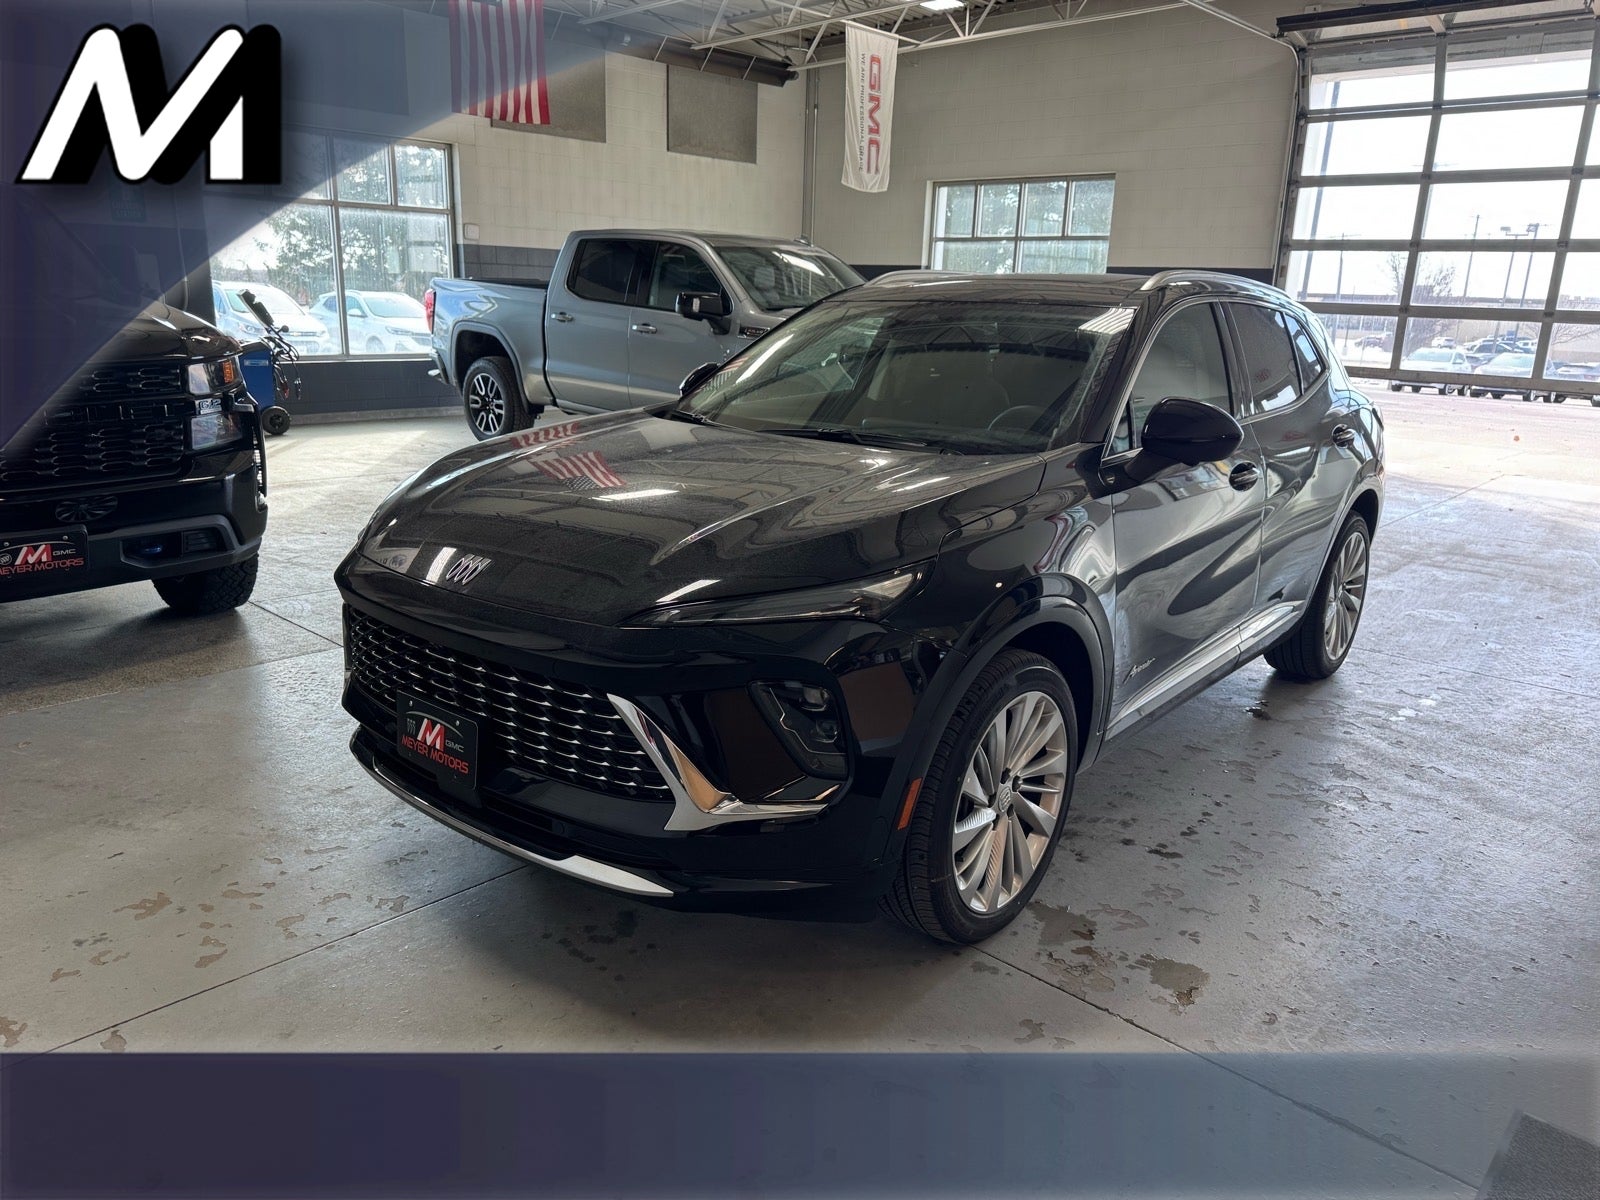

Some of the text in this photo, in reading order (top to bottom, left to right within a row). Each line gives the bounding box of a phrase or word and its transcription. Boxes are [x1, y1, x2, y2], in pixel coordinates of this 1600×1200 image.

[860, 53, 866, 65] WE
[868, 54, 881, 174] GMC
[35, 558, 84, 571] MOTORS
[445, 739, 465, 753] GMC
[401, 735, 469, 774] MEYER MOTORS
